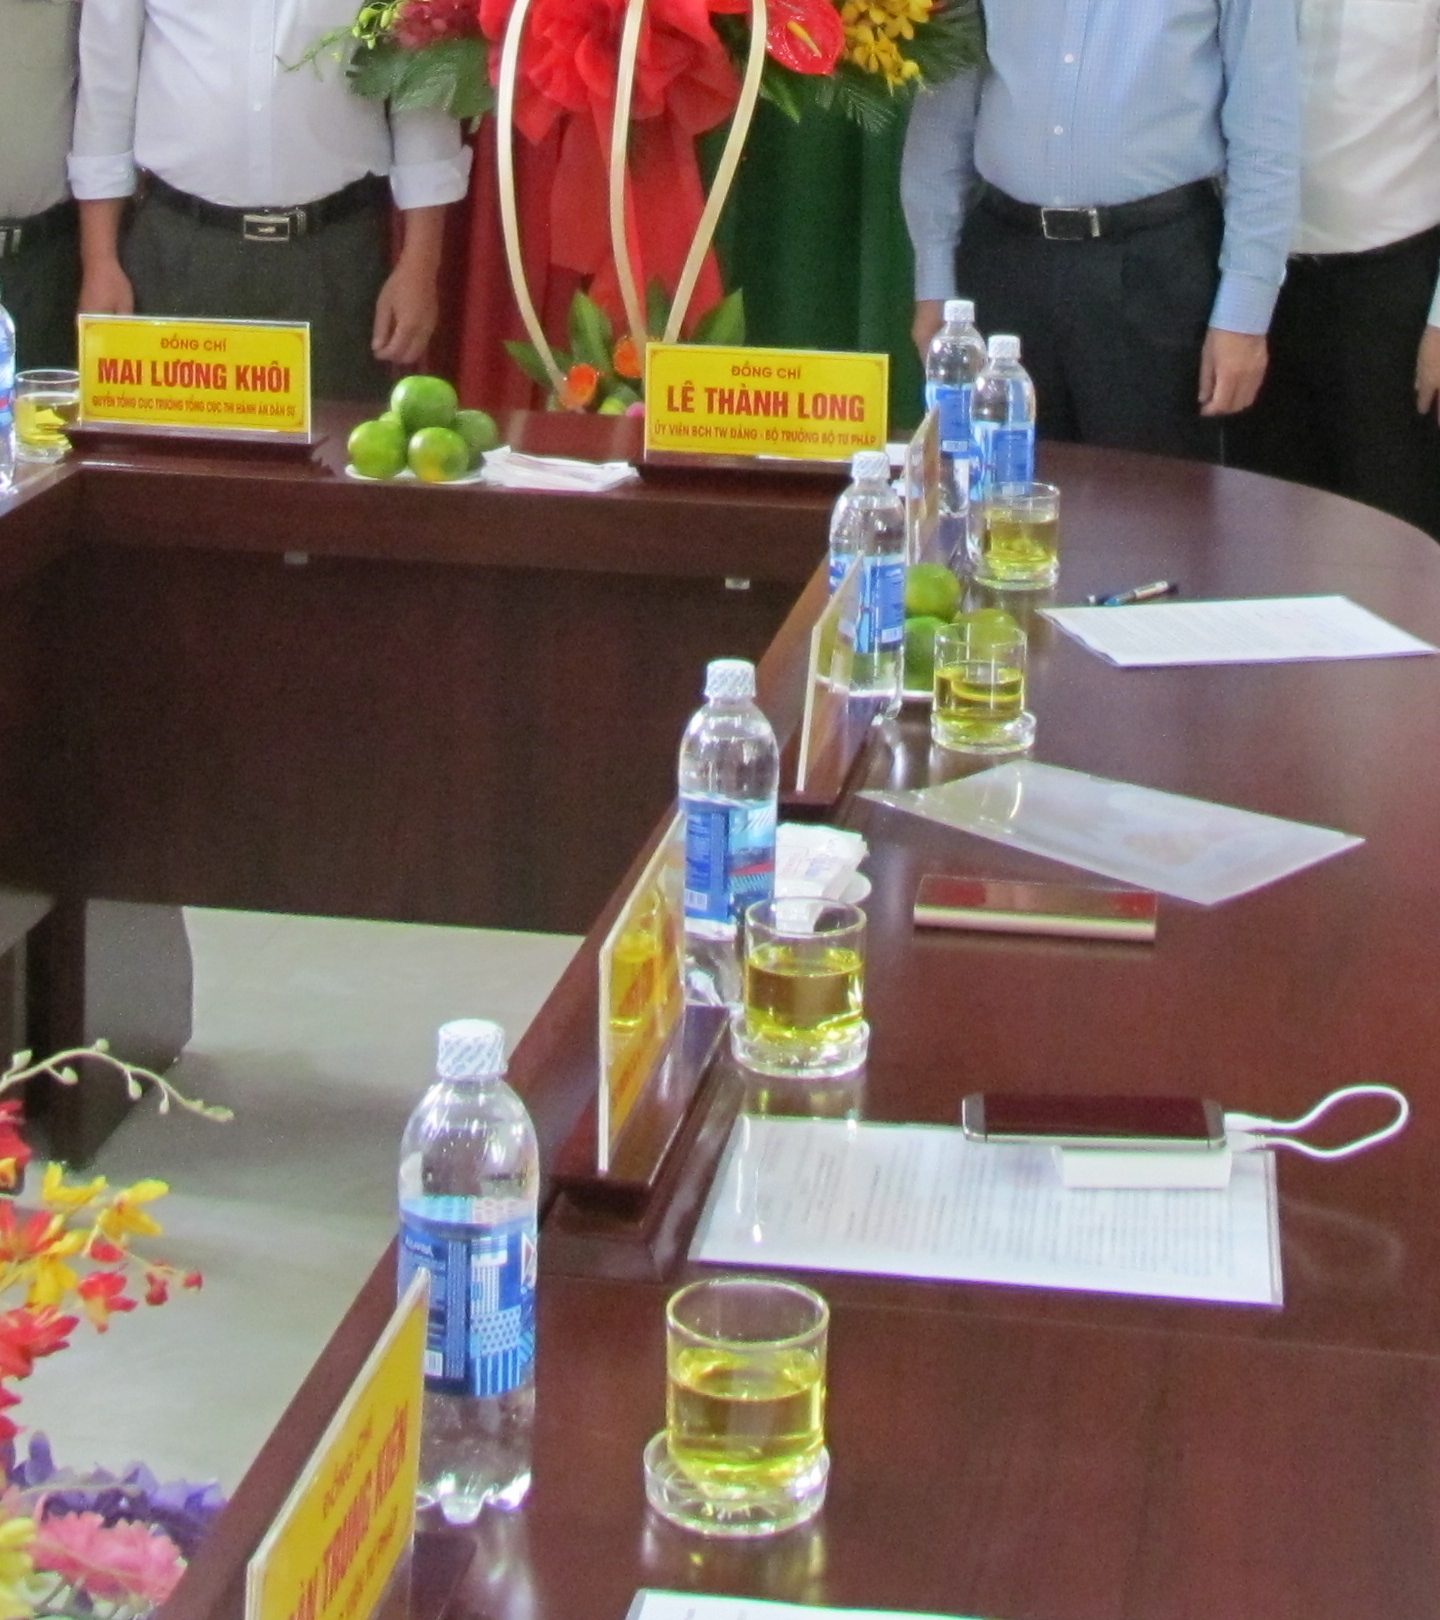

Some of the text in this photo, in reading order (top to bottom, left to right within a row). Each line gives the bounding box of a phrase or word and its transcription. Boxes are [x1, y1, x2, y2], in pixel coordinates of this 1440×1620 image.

[98, 358, 290, 393] MAI LƯƠNG KHÔI
[667, 381, 865, 422] LÊ THÀNH LONG
